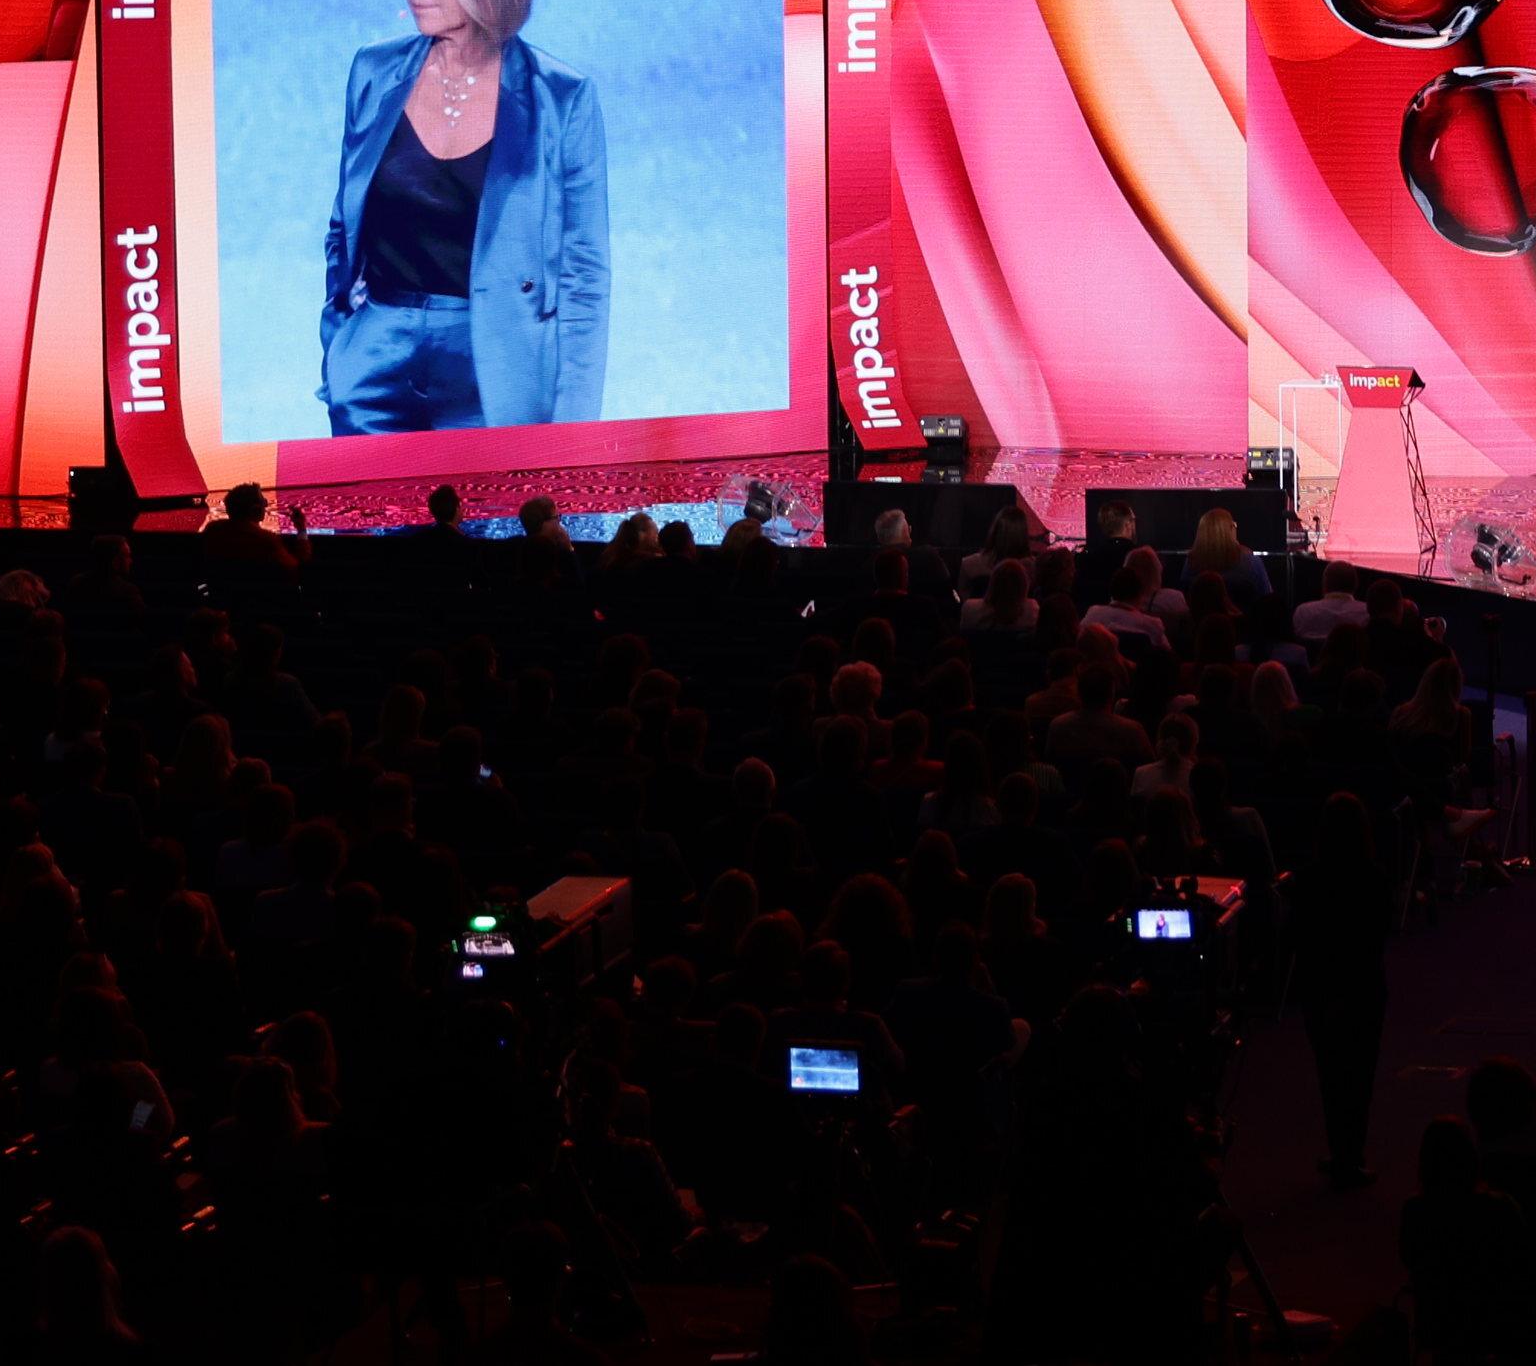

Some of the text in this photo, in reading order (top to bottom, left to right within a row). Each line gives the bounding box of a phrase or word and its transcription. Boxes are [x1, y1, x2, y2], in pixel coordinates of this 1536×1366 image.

[117, 224, 170, 413] impact
[840, 267, 901, 429] impact
[1349, 373, 1400, 390] impact
